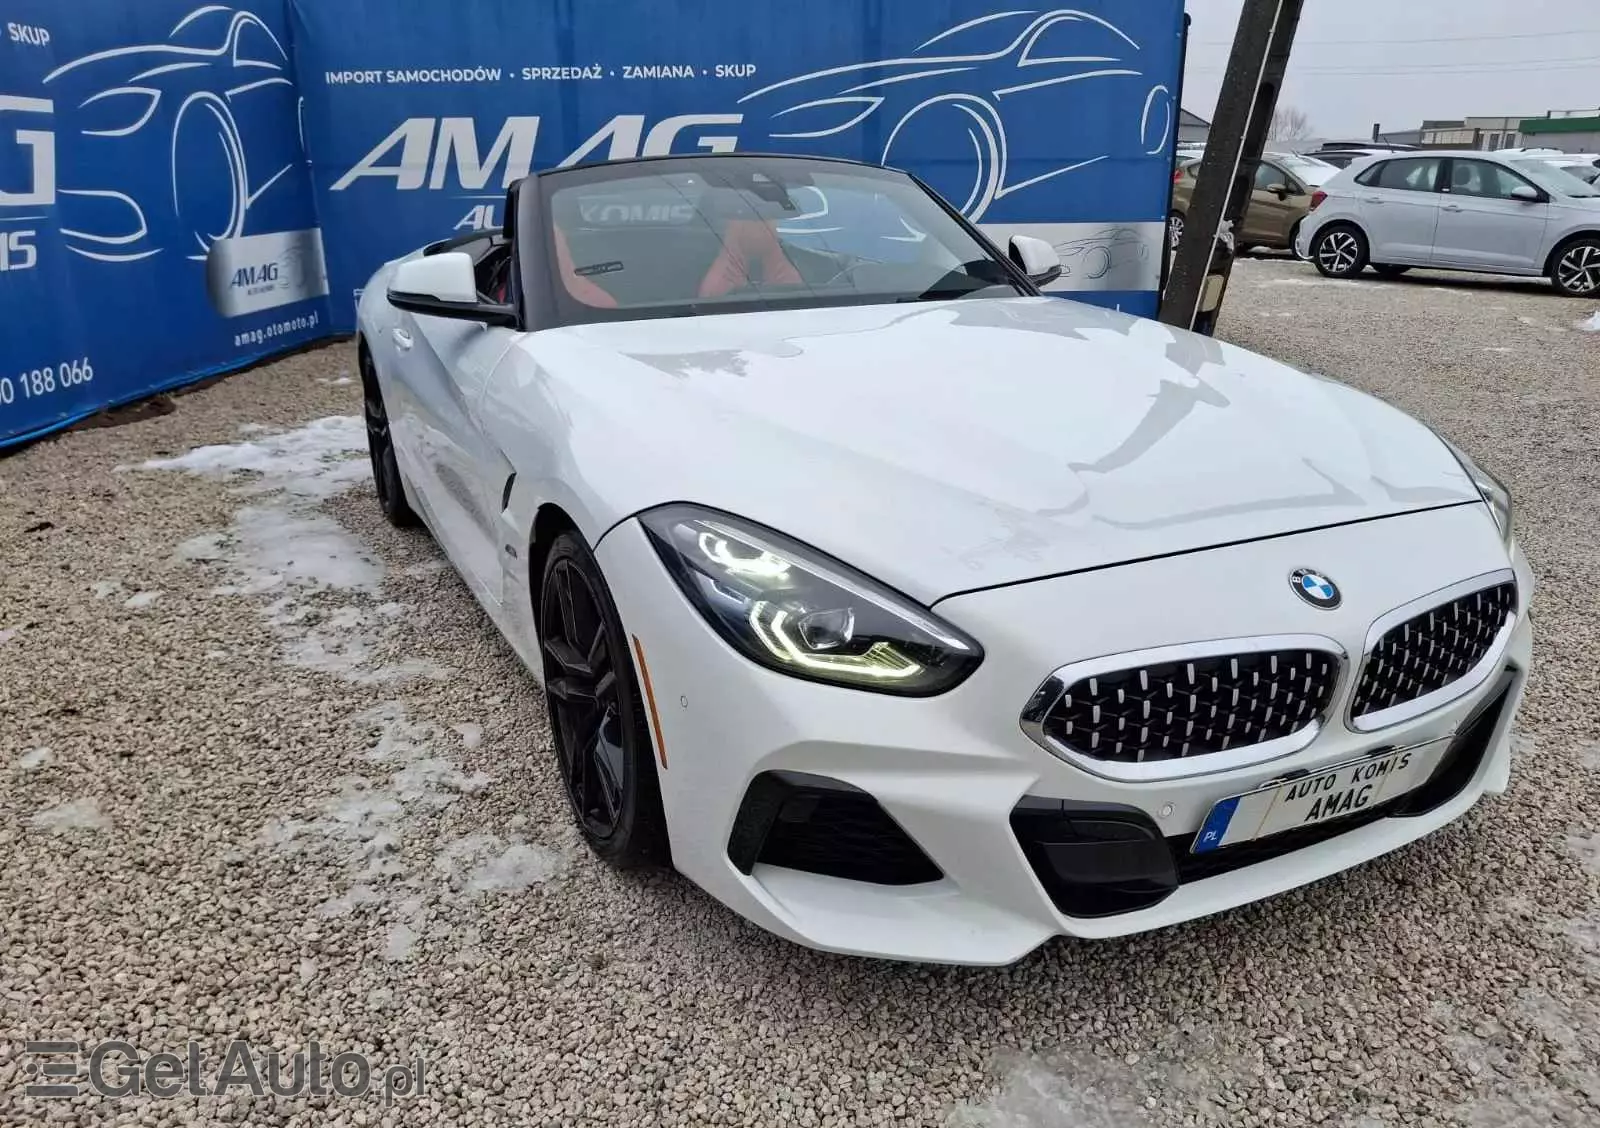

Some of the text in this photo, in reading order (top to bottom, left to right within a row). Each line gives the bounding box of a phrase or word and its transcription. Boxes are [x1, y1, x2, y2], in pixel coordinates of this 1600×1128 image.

[7, 21, 51, 47] SKUP
[325, 63, 757, 85] IMPORT SAMOCHODÓW SPRZEDAŻ ZAMIANA SKUP
[233, 310, 320, 347] amag.otomoto.pl
[0, 356, 94, 405] 0 188 066
[1285, 752, 1413, 802] AUTO KOMIS
[1303, 783, 1374, 822] AMAG
[1203, 831, 1218, 843] PL
